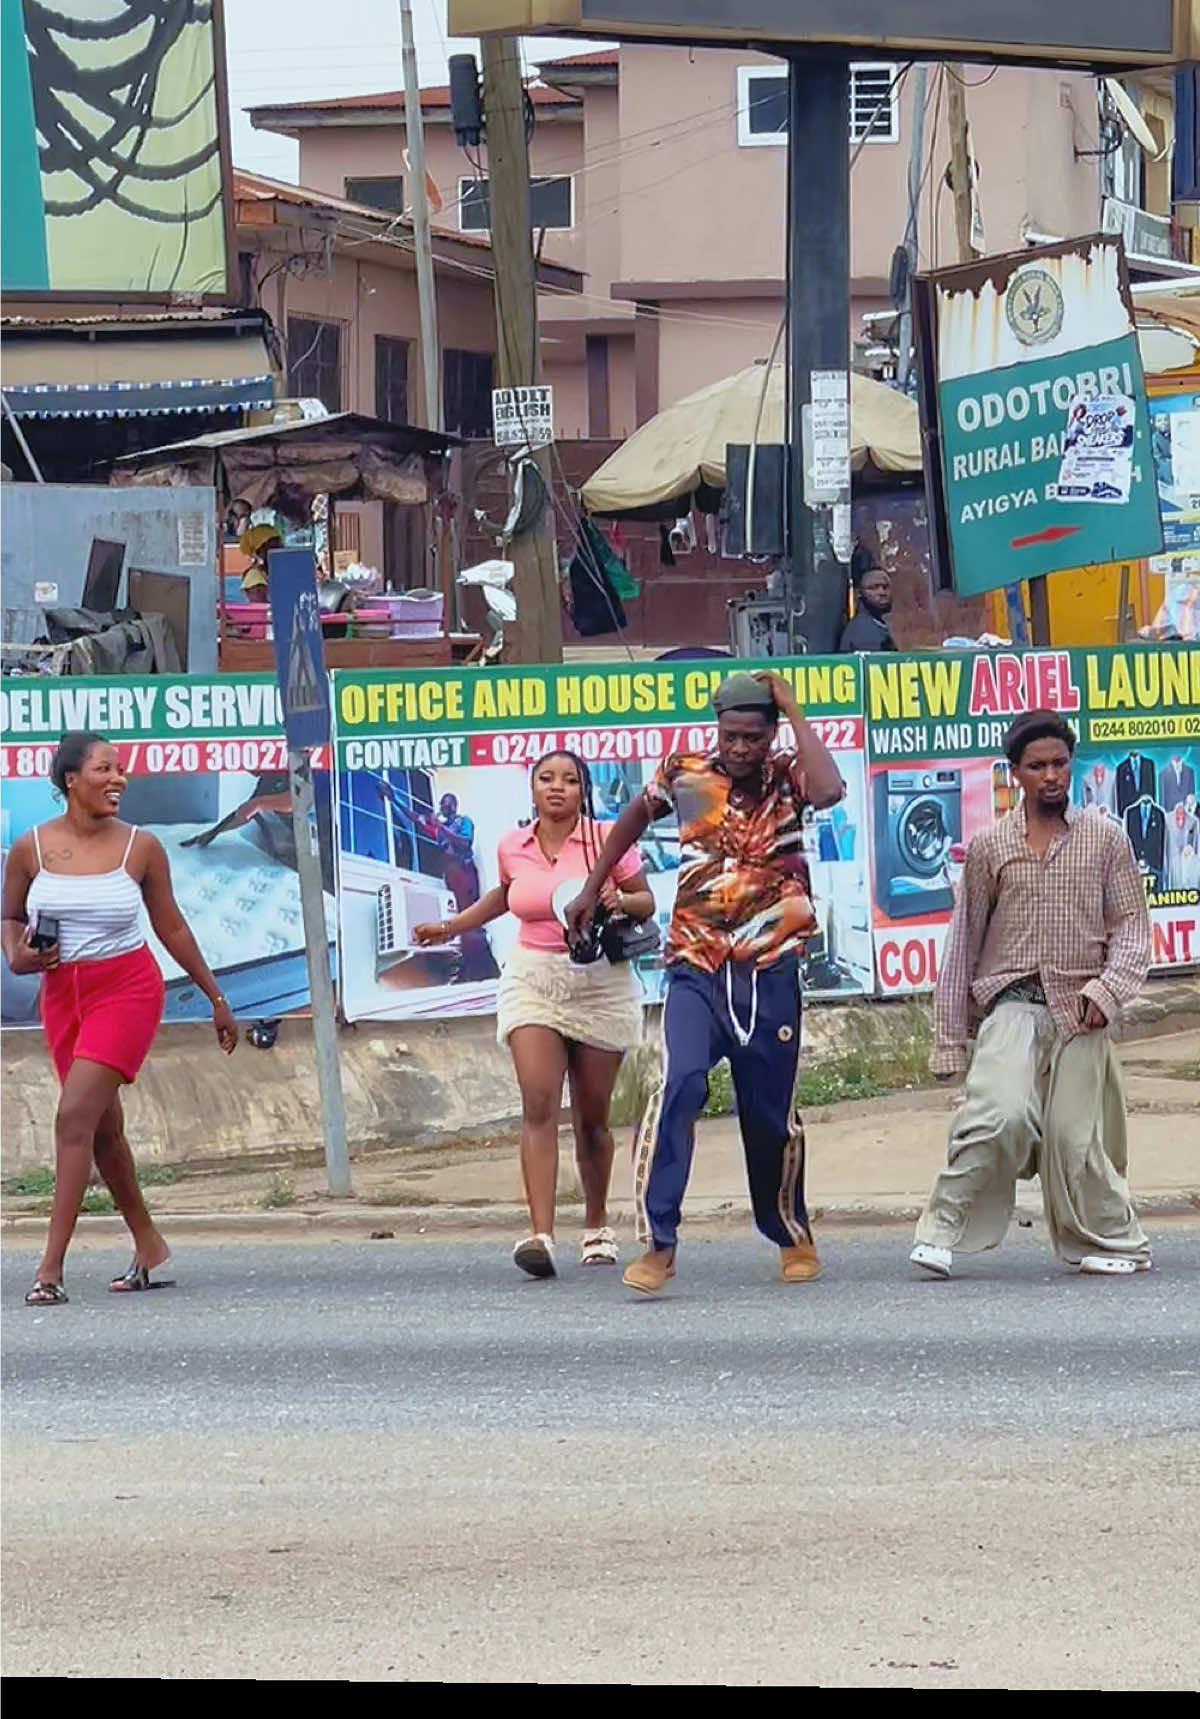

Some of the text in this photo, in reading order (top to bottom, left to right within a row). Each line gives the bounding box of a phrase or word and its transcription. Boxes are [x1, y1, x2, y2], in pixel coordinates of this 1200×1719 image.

[957, 362, 1133, 433] ODOTOBRI
[953, 431, 1066, 481] RURAL BA
[961, 488, 1038, 524] AYIGYA
[341, 663, 856, 725] OFFICE AND HOUSE CING
[869, 659, 961, 721] NEW
[969, 651, 1080, 716] ARIEL
[345, 736, 465, 771] CONTACT
[492, 733, 557, 764] 0244
[564, 729, 662, 760] 802010
[670, 729, 682, 755] /
[688, 726, 719, 753] 02
[871, 726, 927, 755] WASH
[933, 722, 970, 750] AND
[1093, 721, 1125, 738] 0244
[1128, 720, 1176, 737] 802010
[126, 740, 323, 773] / 020 300272
[1146, 889, 1199, 906] ANING
[1152, 919, 1196, 964] NT
